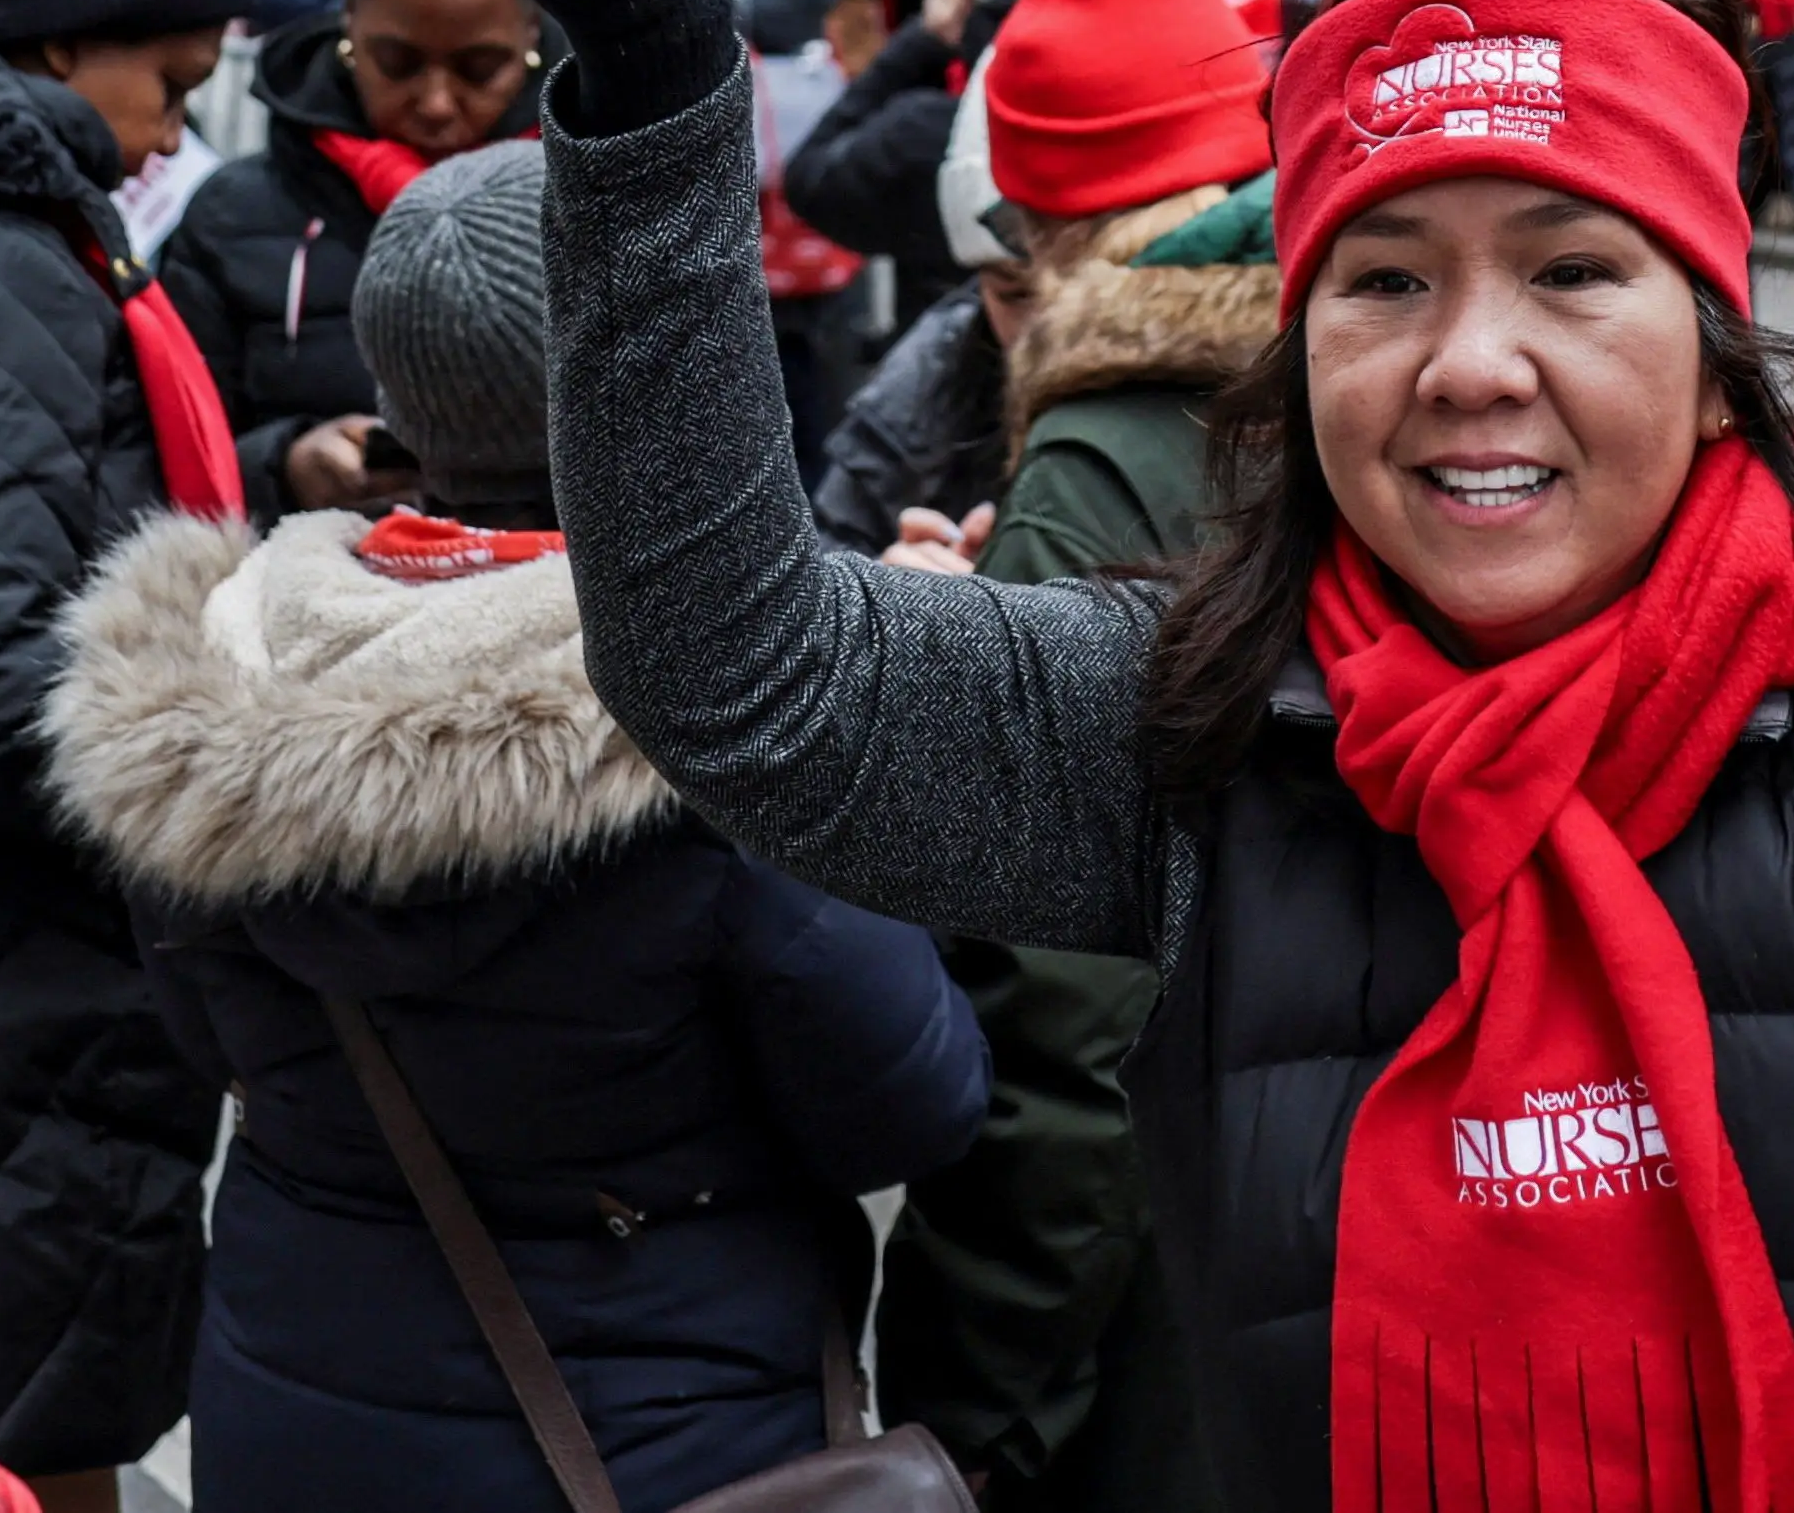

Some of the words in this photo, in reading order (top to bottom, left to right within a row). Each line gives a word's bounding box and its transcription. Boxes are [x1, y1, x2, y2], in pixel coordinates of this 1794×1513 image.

[1434, 40, 1473, 54] New
[1478, 35, 1514, 51] York
[1518, 35, 1562, 52] State
[1373, 49, 1562, 105] NURSES
[1373, 85, 1563, 121] ASSOCIATION
[1493, 103, 1566, 123] National
[1493, 116, 1551, 135] Nurses
[1523, 1087, 1576, 1115] New
[1578, 1077, 1630, 1106] York
[1452, 1104, 1671, 1179] NURSE
[1458, 1163, 1678, 1208] ASSOCIATIO
